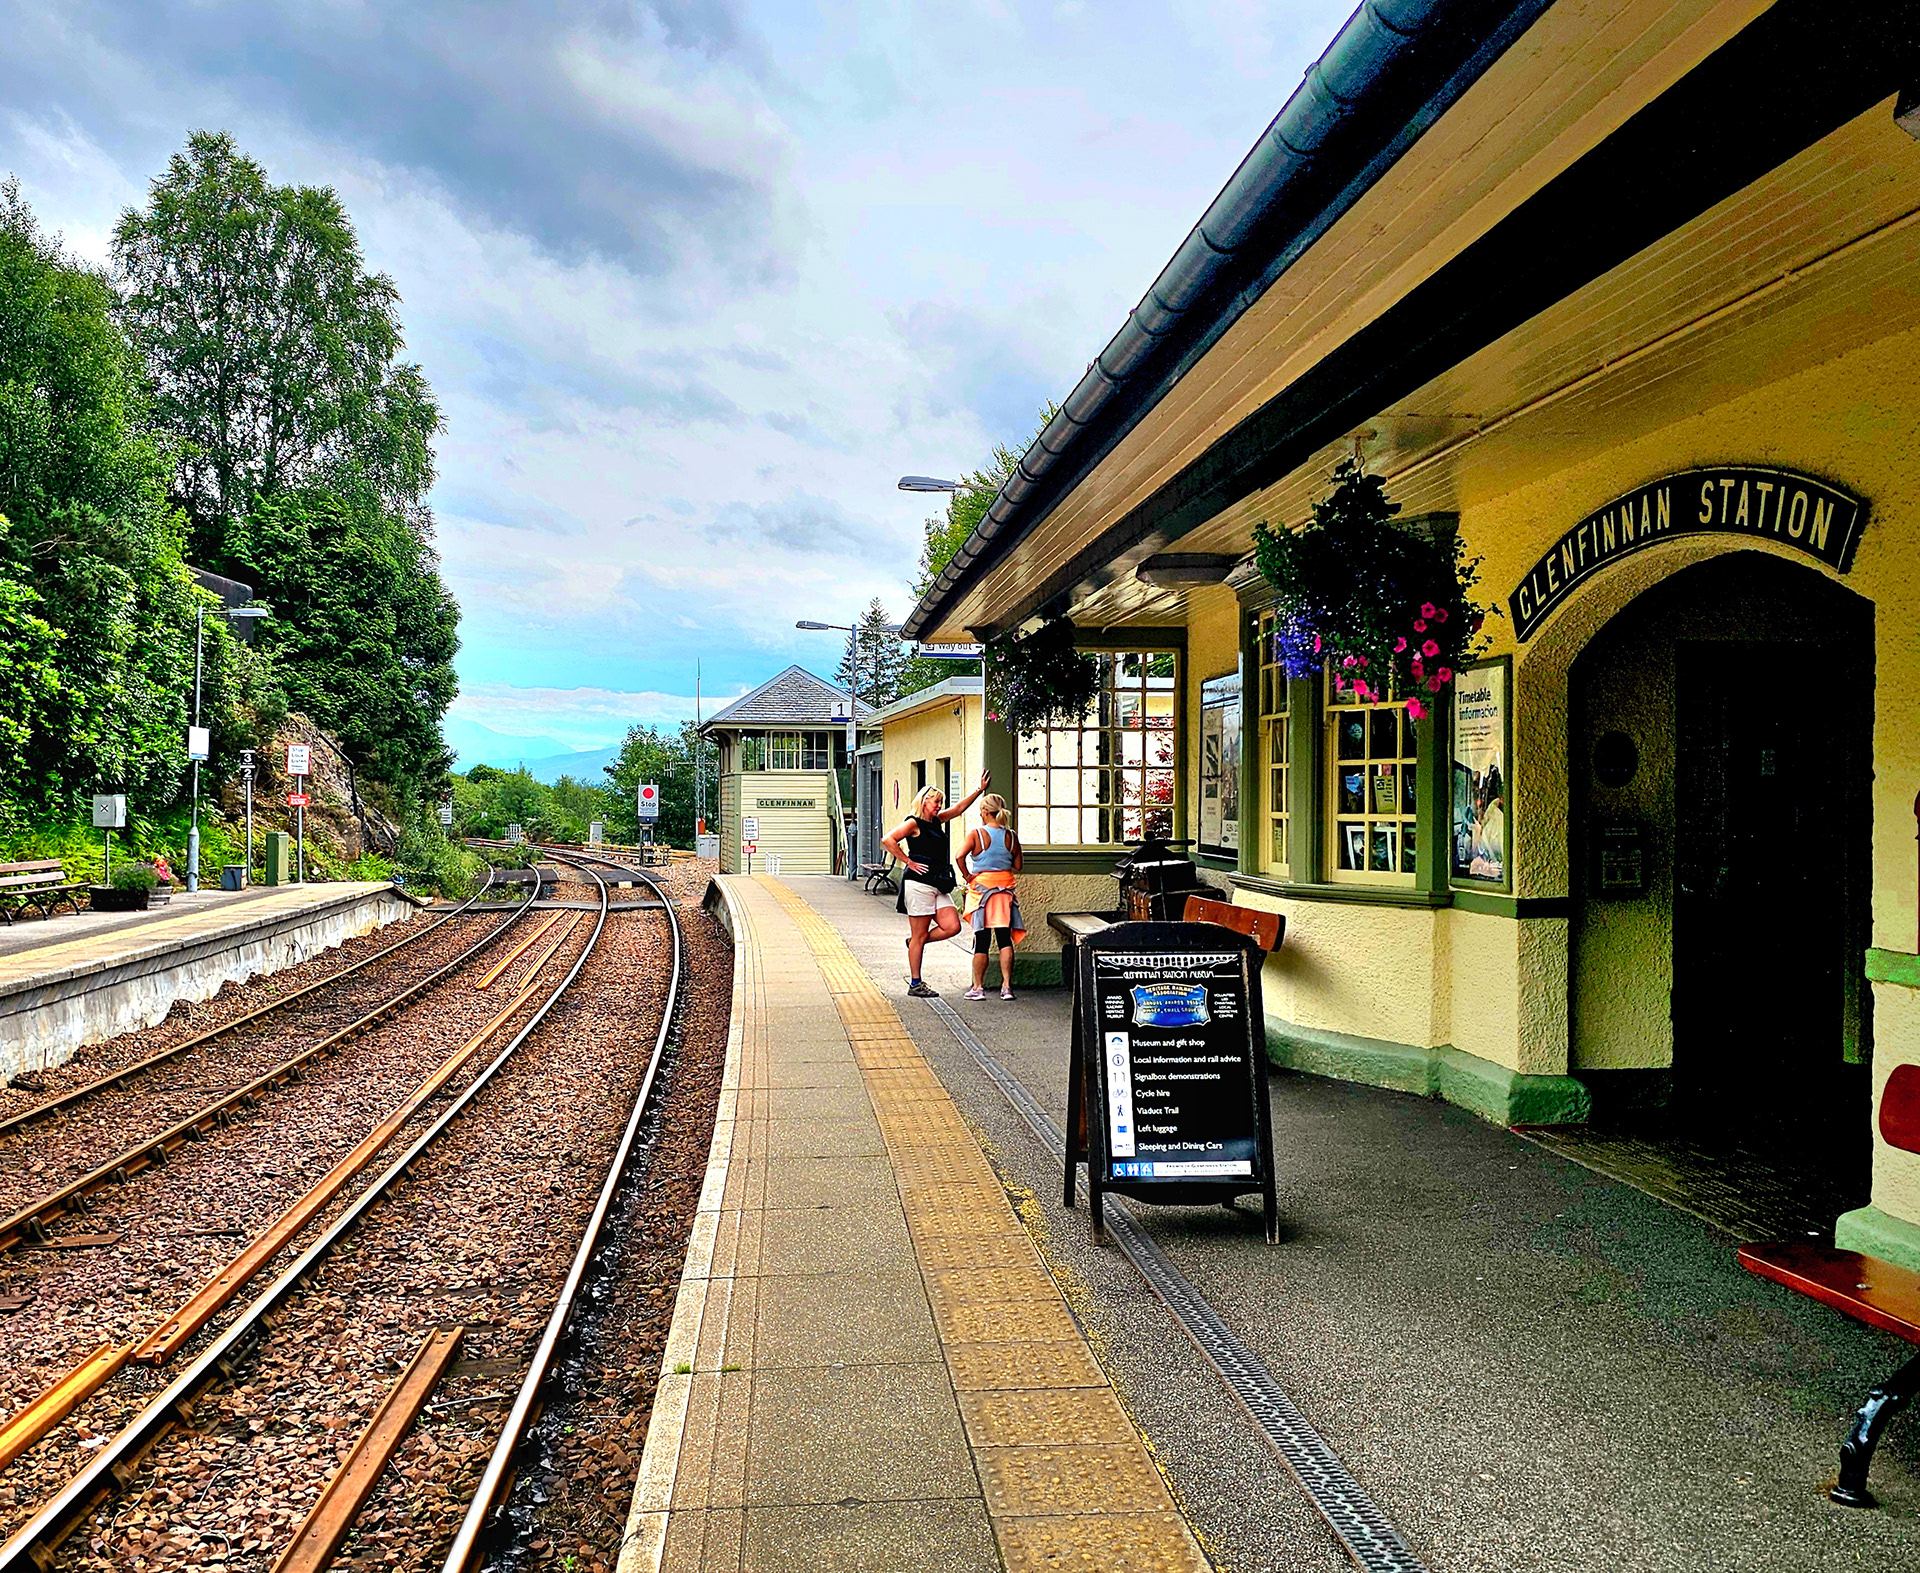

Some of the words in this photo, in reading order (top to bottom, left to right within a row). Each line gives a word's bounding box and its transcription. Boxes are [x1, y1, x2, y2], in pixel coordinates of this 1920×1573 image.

[1519, 486, 1670, 621] GLENFINNAN
[1699, 478, 1834, 551] STATION
[957, 643, 972, 651] out
[1458, 687, 1491, 704] Timetable
[837, 702, 845, 716] 1
[1459, 704, 1498, 720] information
[243, 753, 252, 763] 3
[243, 768, 252, 778] 2
[641, 800, 657, 808] Stop
[1162, 970, 1187, 979] STATION
[1189, 970, 1215, 979] MUSEUM
[1132, 1039, 1161, 1047] Museum
[1163, 1039, 1175, 1047] and
[1176, 1038, 1188, 1048] gift
[1189, 1038, 1206, 1048] shop
[1133, 1056, 1152, 1064] Local
[1193, 1055, 1206, 1063] and
[1207, 1055, 1219, 1063] rail
[1220, 1055, 1242, 1063] advice
[1134, 1073, 1167, 1082] Signalbox
[1168, 1072, 1221, 1080] demonstrations
[1135, 1090, 1155, 1098] Cycle
[1156, 1089, 1171, 1097] hire
[1136, 1107, 1163, 1115] Viaduct
[1137, 1124, 1151, 1132] Left
[1152, 1124, 1178, 1133] luggage
[1138, 1142, 1167, 1152] Sleeping
[1168, 1142, 1181, 1150] and
[1182, 1142, 1206, 1151] Dining
[1206, 1141, 1223, 1150] Cars
